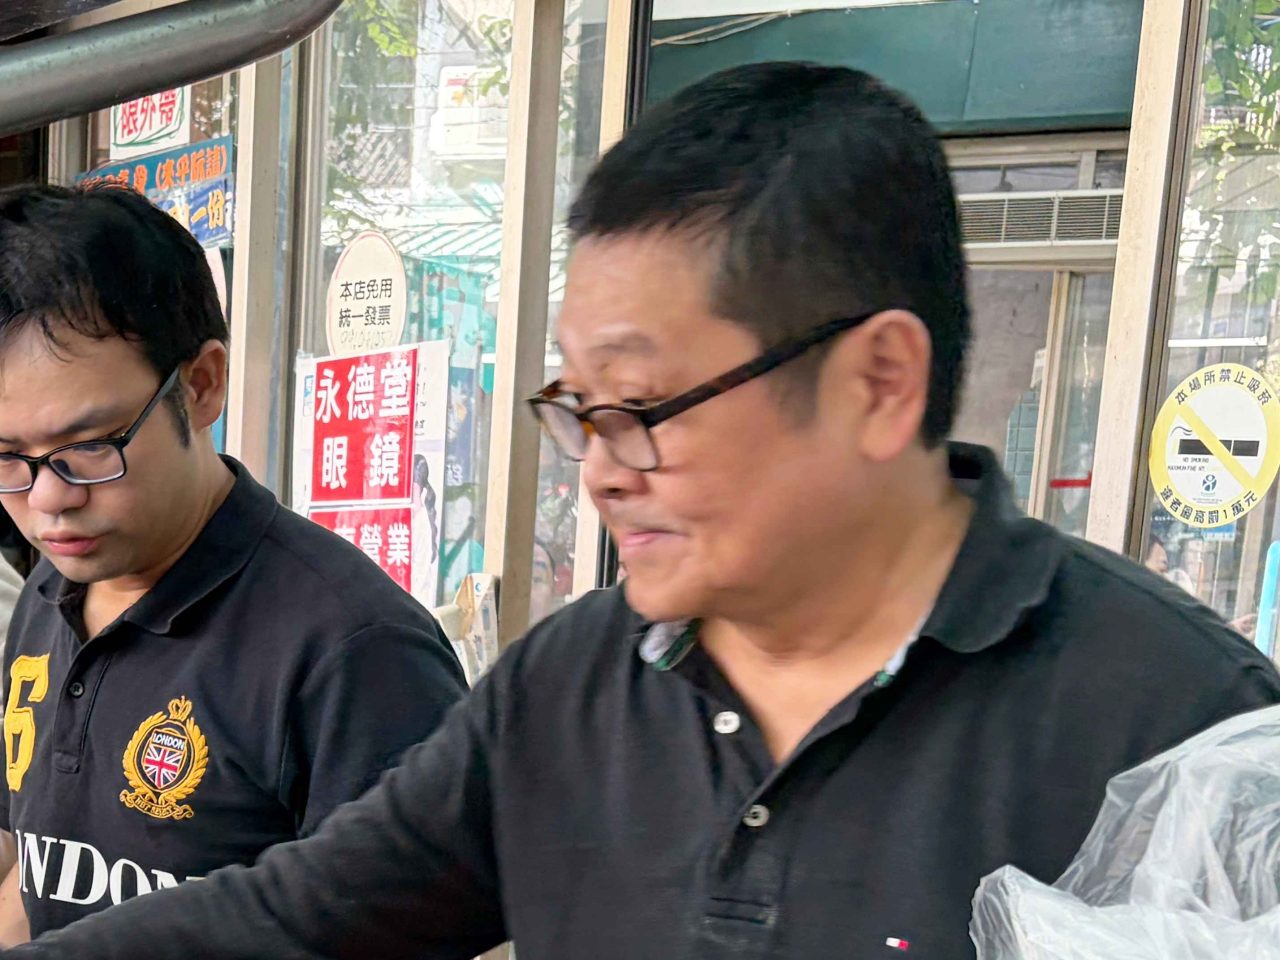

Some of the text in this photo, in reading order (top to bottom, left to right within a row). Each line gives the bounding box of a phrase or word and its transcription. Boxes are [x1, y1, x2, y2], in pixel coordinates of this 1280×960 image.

[340, 278, 392, 301] 本店免用
[338, 305, 391, 327] 統一發票
[316, 358, 412, 423] 永德堂
[321, 432, 401, 489] 眼鏡
[152, 732, 185, 750] LONDON
